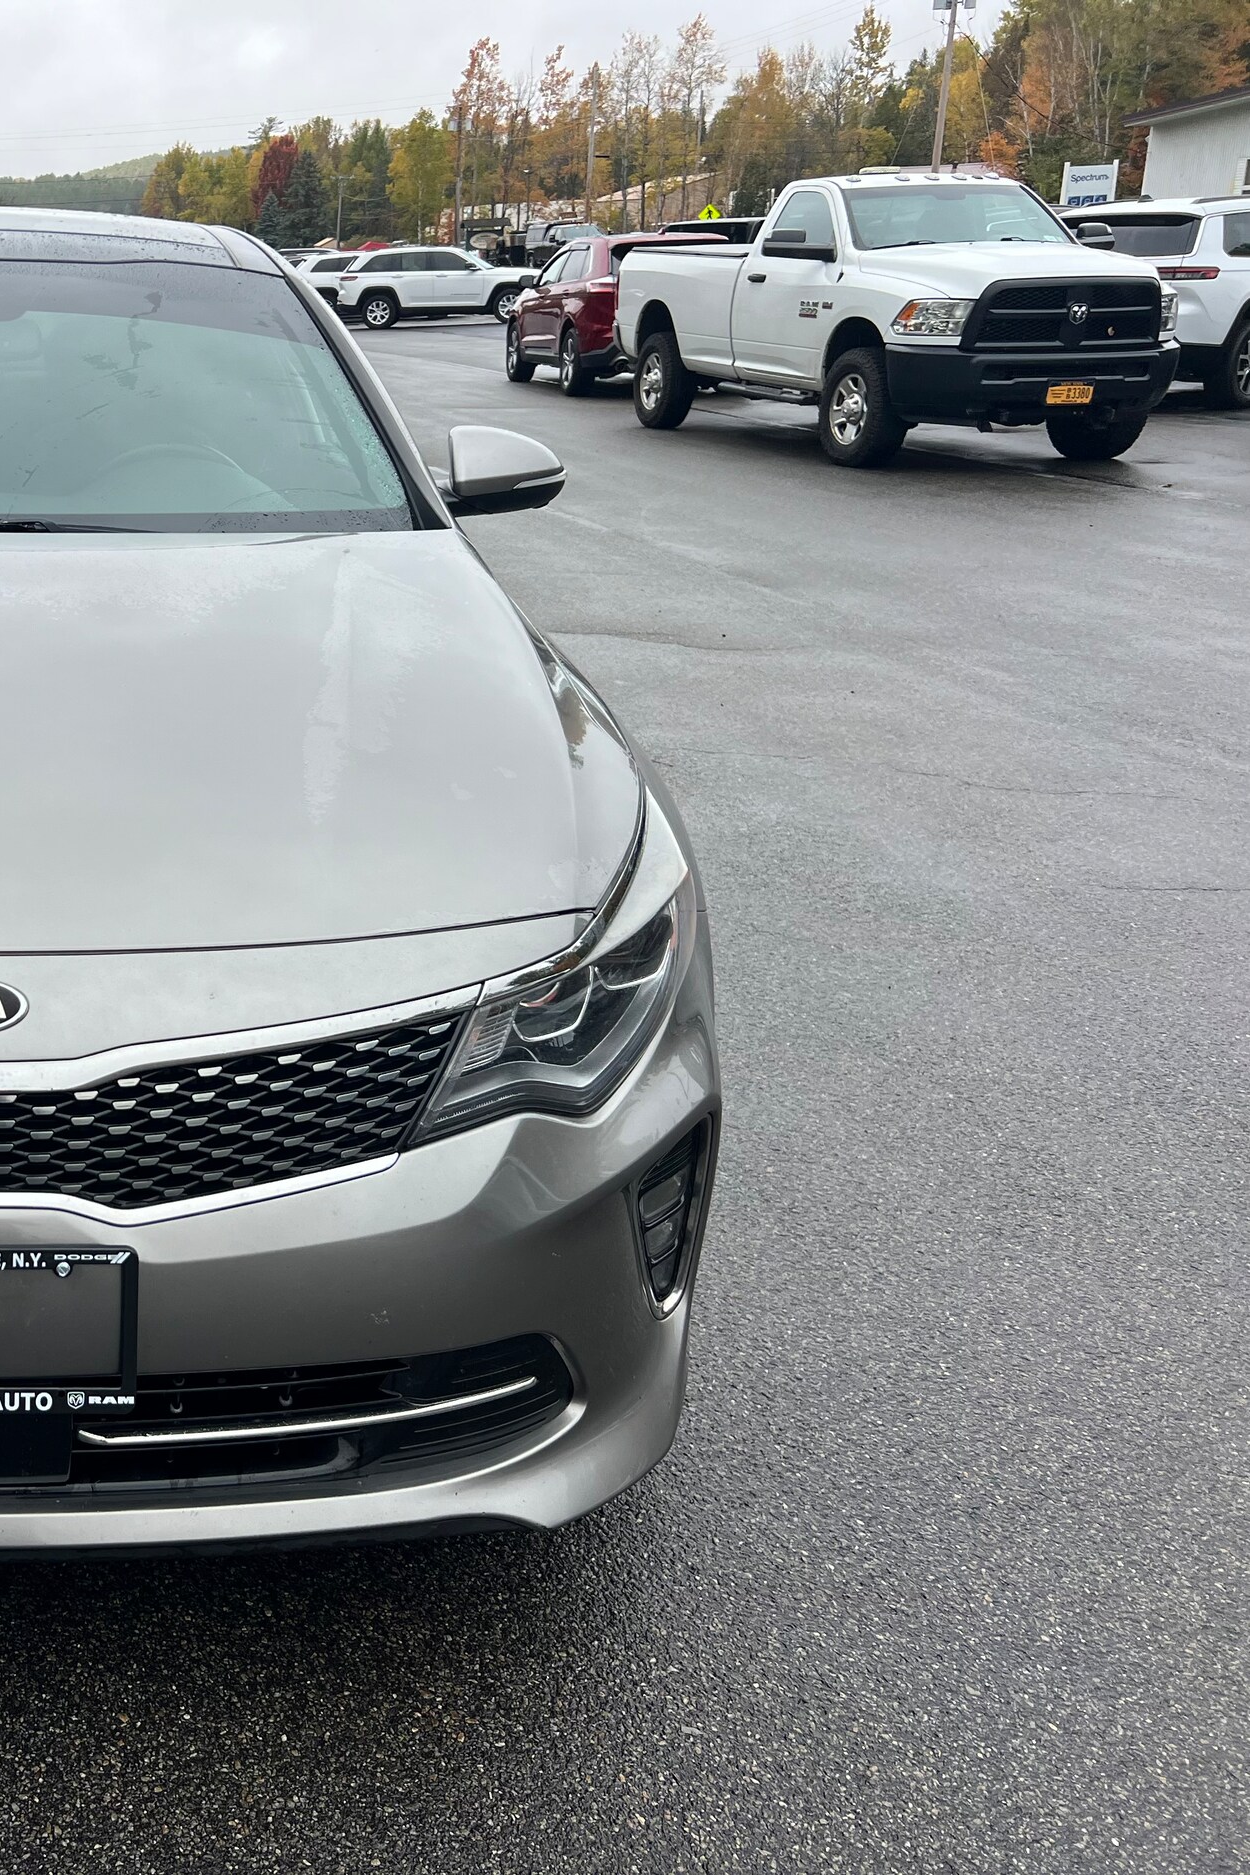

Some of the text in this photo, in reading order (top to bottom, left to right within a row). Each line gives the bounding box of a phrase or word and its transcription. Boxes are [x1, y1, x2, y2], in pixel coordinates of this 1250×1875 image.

[1070, 174, 1109, 184] Spectrum
[13, 1252, 47, 1268] N.Y.
[54, 1253, 118, 1261] DODGE
[88, 1395, 135, 1405] RAM
